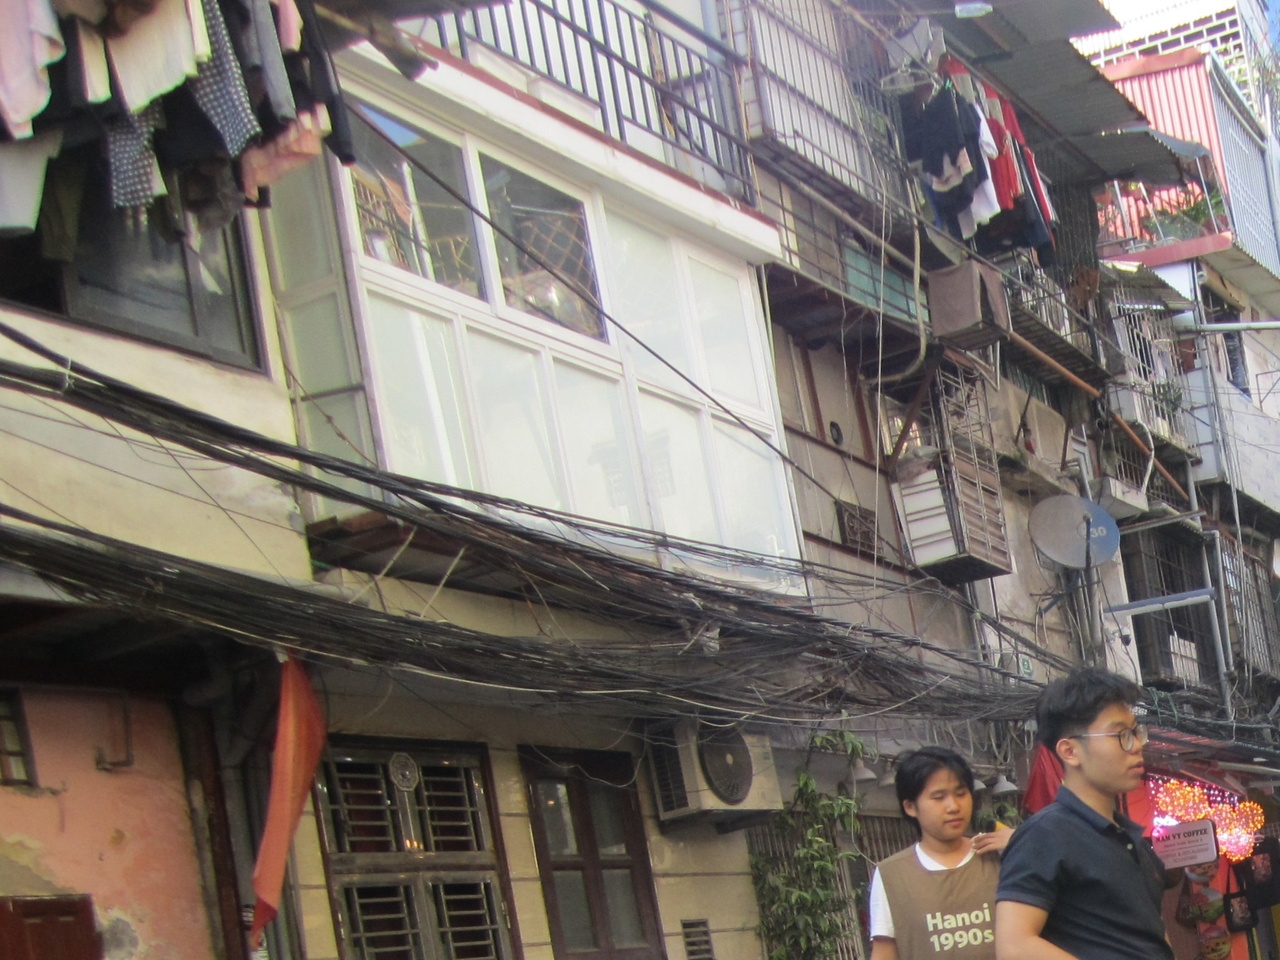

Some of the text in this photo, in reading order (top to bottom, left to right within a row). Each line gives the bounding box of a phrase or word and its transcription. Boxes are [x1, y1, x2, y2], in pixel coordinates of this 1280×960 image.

[1183, 828, 1208, 838] COFFEE
[926, 903, 991, 932] Hanoi
[930, 928, 995, 952] 1990s
